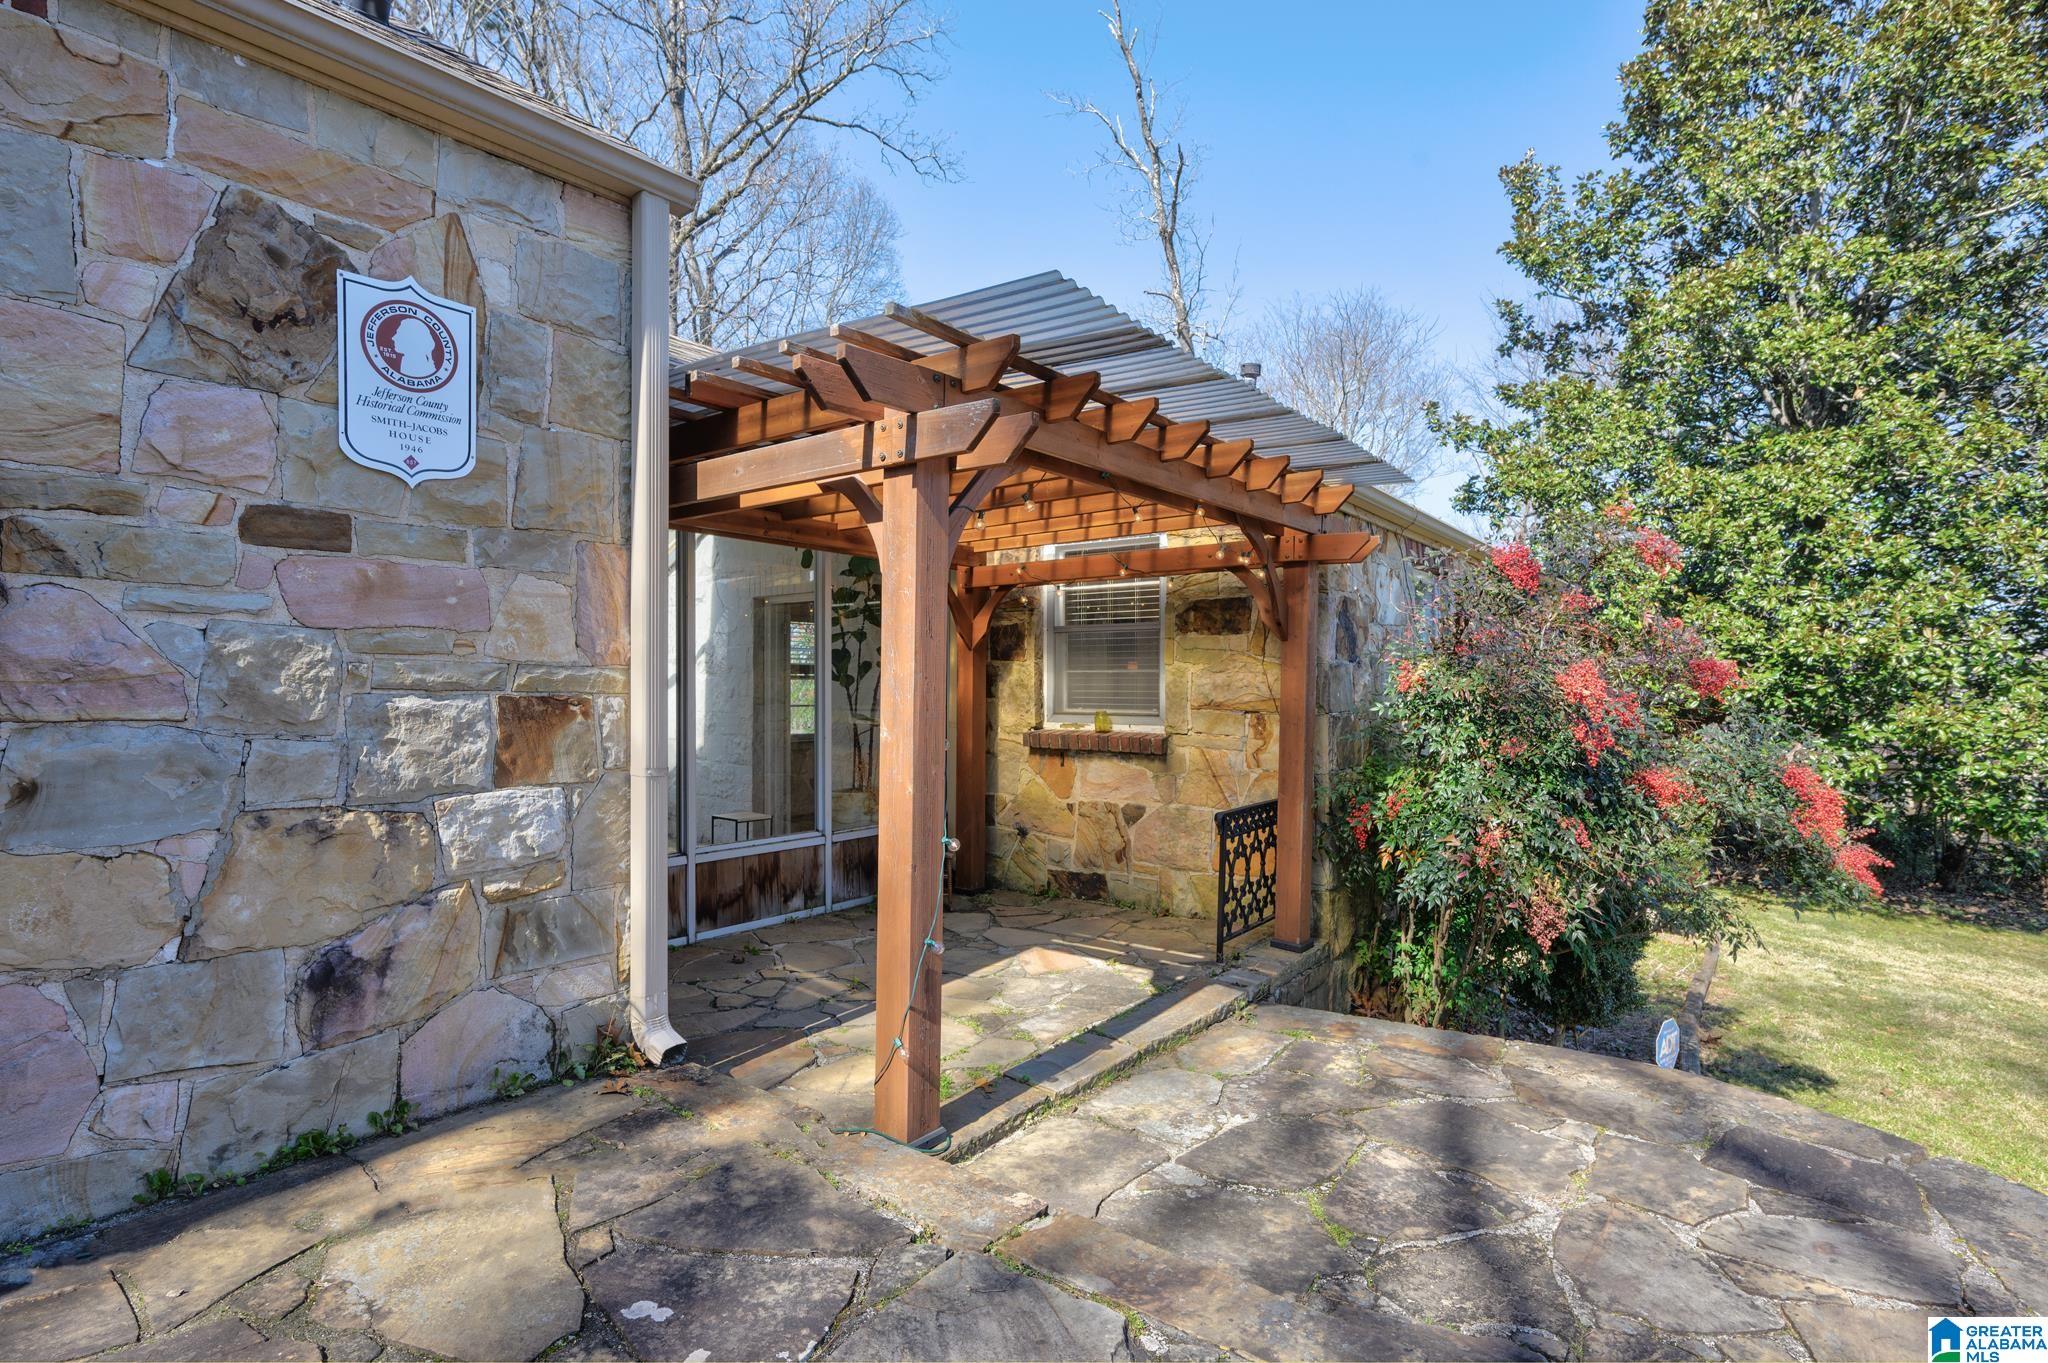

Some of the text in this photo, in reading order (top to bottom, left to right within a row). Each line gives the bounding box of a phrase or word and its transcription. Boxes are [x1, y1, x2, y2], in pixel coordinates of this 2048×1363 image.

[366, 305, 452, 365] JEFFERSON COUNTY
[381, 366, 443, 387] ALABAMA
[355, 394, 462, 425] Historical Commission
[371, 386, 449, 412] Jefferson County
[371, 415, 448, 436] SMITH-JACOBS
[388, 430, 432, 444] HOUSE
[399, 443, 424, 454] 1946
